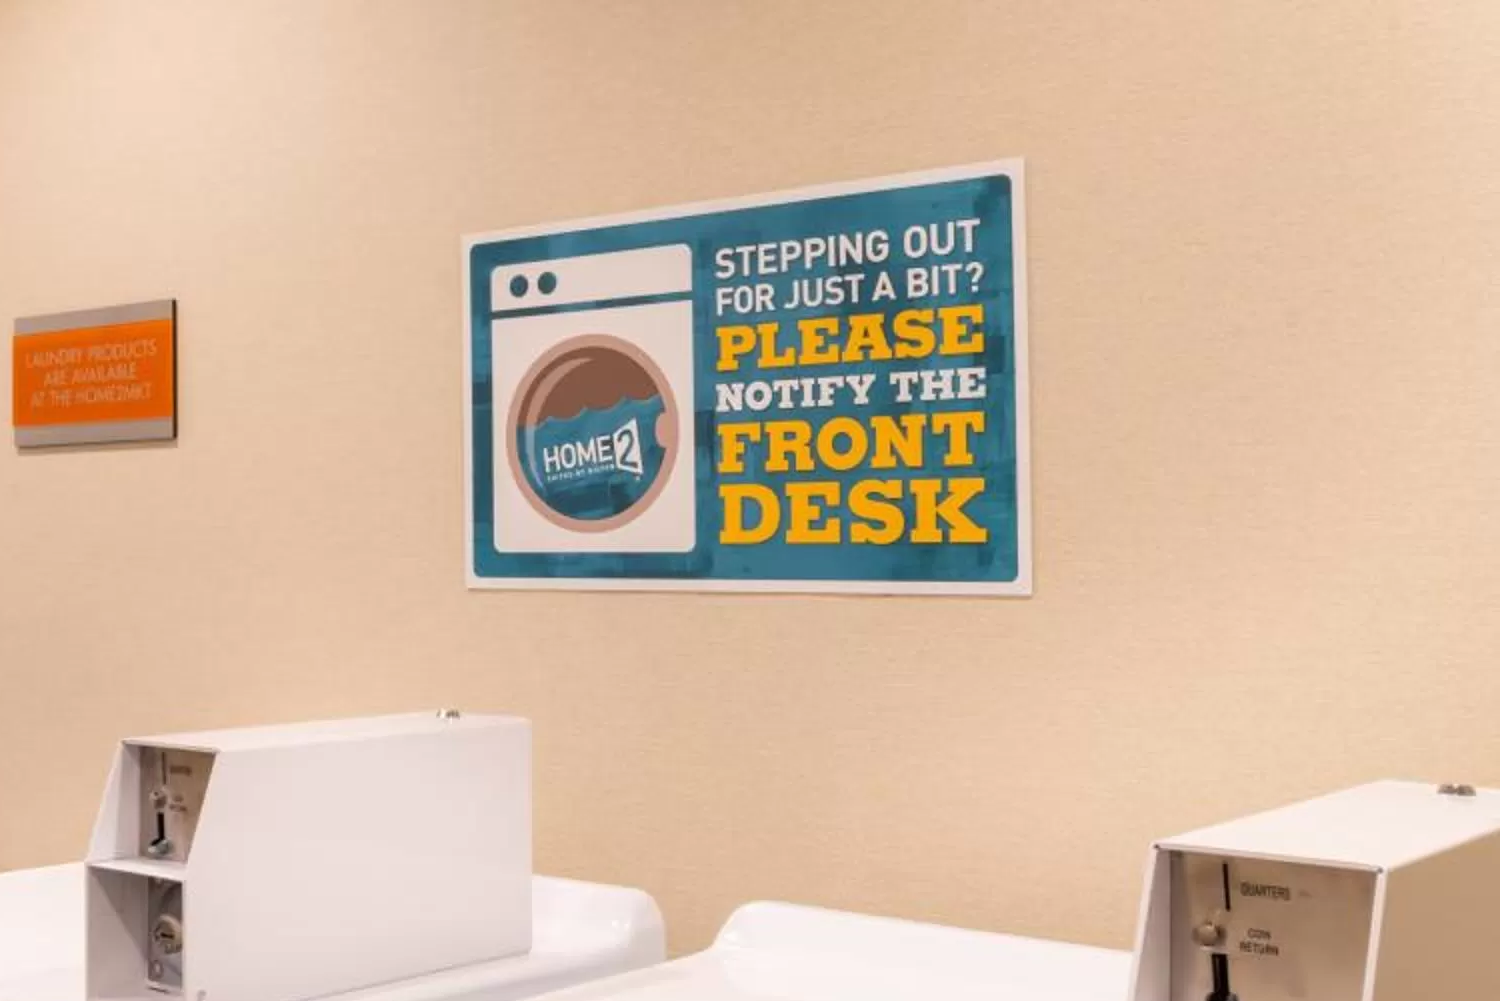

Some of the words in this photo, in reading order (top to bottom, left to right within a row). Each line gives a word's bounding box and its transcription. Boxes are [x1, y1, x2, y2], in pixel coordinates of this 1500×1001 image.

[715, 229, 889, 279] STEPPING
[903, 218, 981, 259] OUT
[716, 283, 776, 317] FOR
[784, 274, 865, 310] JUST
[871, 271, 897, 302] A
[906, 261, 985, 299] BIT?
[715, 304, 985, 372] PLEASE
[715, 373, 877, 413] NOTIFY
[889, 366, 988, 403] THE
[716, 411, 986, 473] FRONT
[718, 477, 989, 546] DESK
[1239, 941, 1279, 957] RETURN
